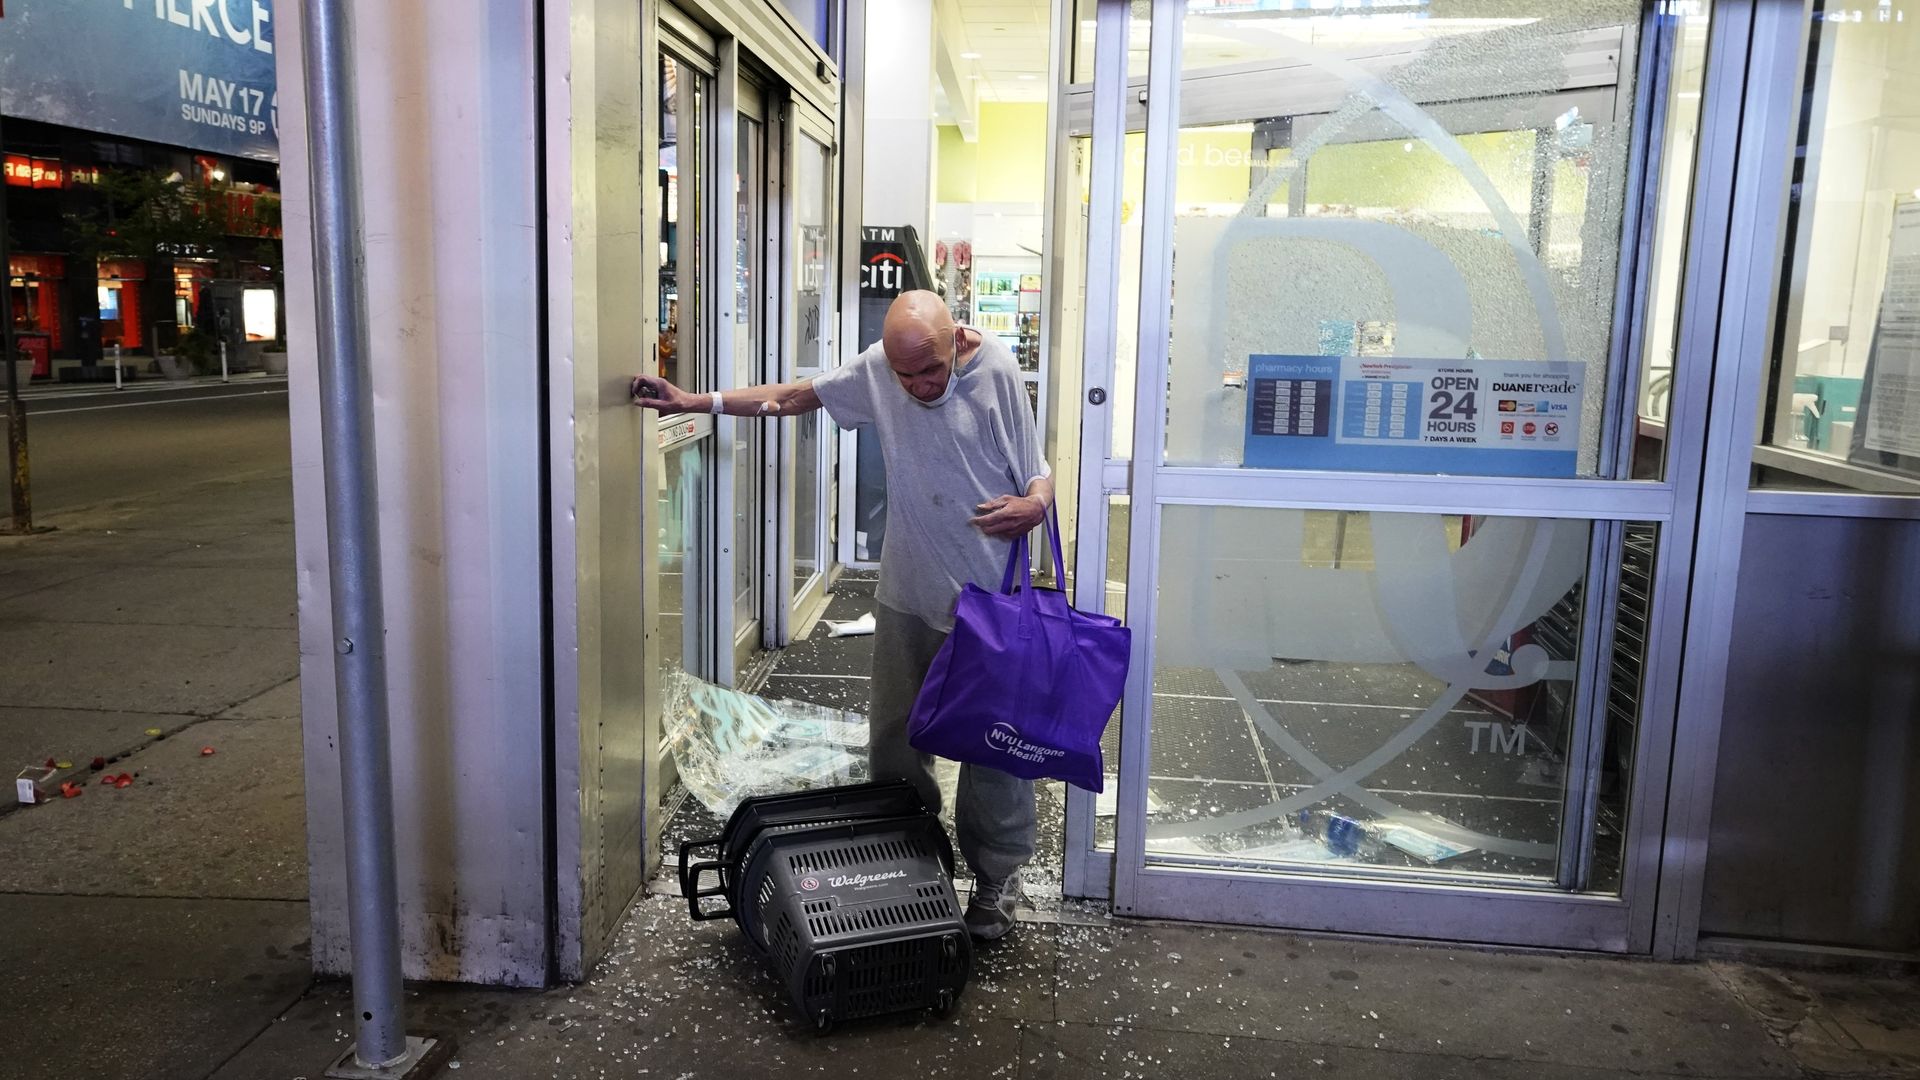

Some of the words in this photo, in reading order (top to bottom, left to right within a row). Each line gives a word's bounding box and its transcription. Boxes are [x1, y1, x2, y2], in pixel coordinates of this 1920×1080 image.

[179, 69, 236, 110] MAY
[238, 87, 264, 116] 17
[181, 104, 246, 132] SUNDAYS
[249, 119, 266, 135] 9P
[860, 259, 902, 289] citi
[1255, 363, 1302, 374] pharmacy
[1305, 364, 1333, 374] hours
[1431, 377, 1479, 391] OPEN
[1428, 391, 1478, 420] 24
[1427, 421, 1476, 433] HOURS
[991, 728, 1018, 745] NYU
[1017, 740, 1065, 757] Langone
[1464, 721, 1527, 754] TM
[1007, 746, 1045, 763] Health
[827, 870, 907, 887] Walgreens
